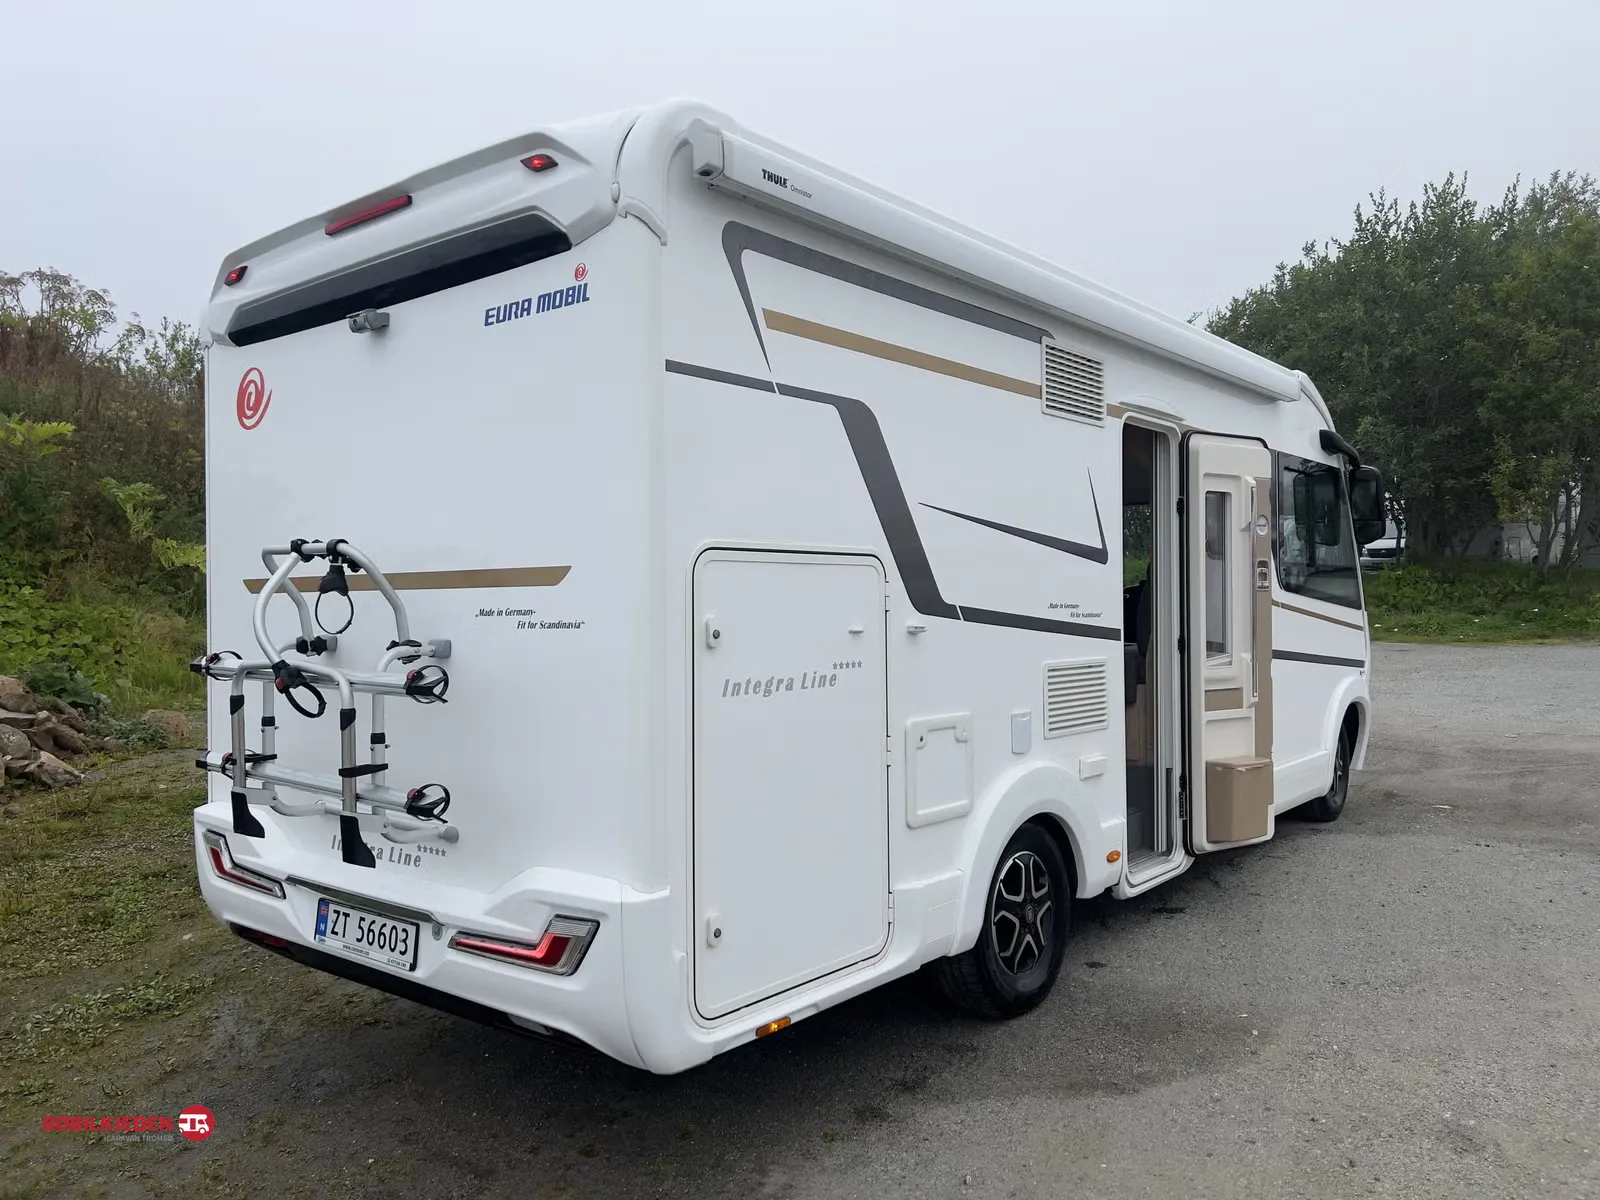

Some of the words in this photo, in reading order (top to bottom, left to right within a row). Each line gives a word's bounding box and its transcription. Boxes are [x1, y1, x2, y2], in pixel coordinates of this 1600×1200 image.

[762, 168, 788, 188] THULE
[484, 298, 532, 326] EURA
[536, 283, 590, 314] MOBIL
[496, 607, 504, 616] in
[516, 620, 526, 630] Fit
[527, 620, 539, 630] for
[722, 676, 795, 698] Integra
[800, 670, 837, 690] Line
[388, 846, 422, 868] Line
[330, 909, 350, 938] ZT
[356, 916, 410, 956] 56603
